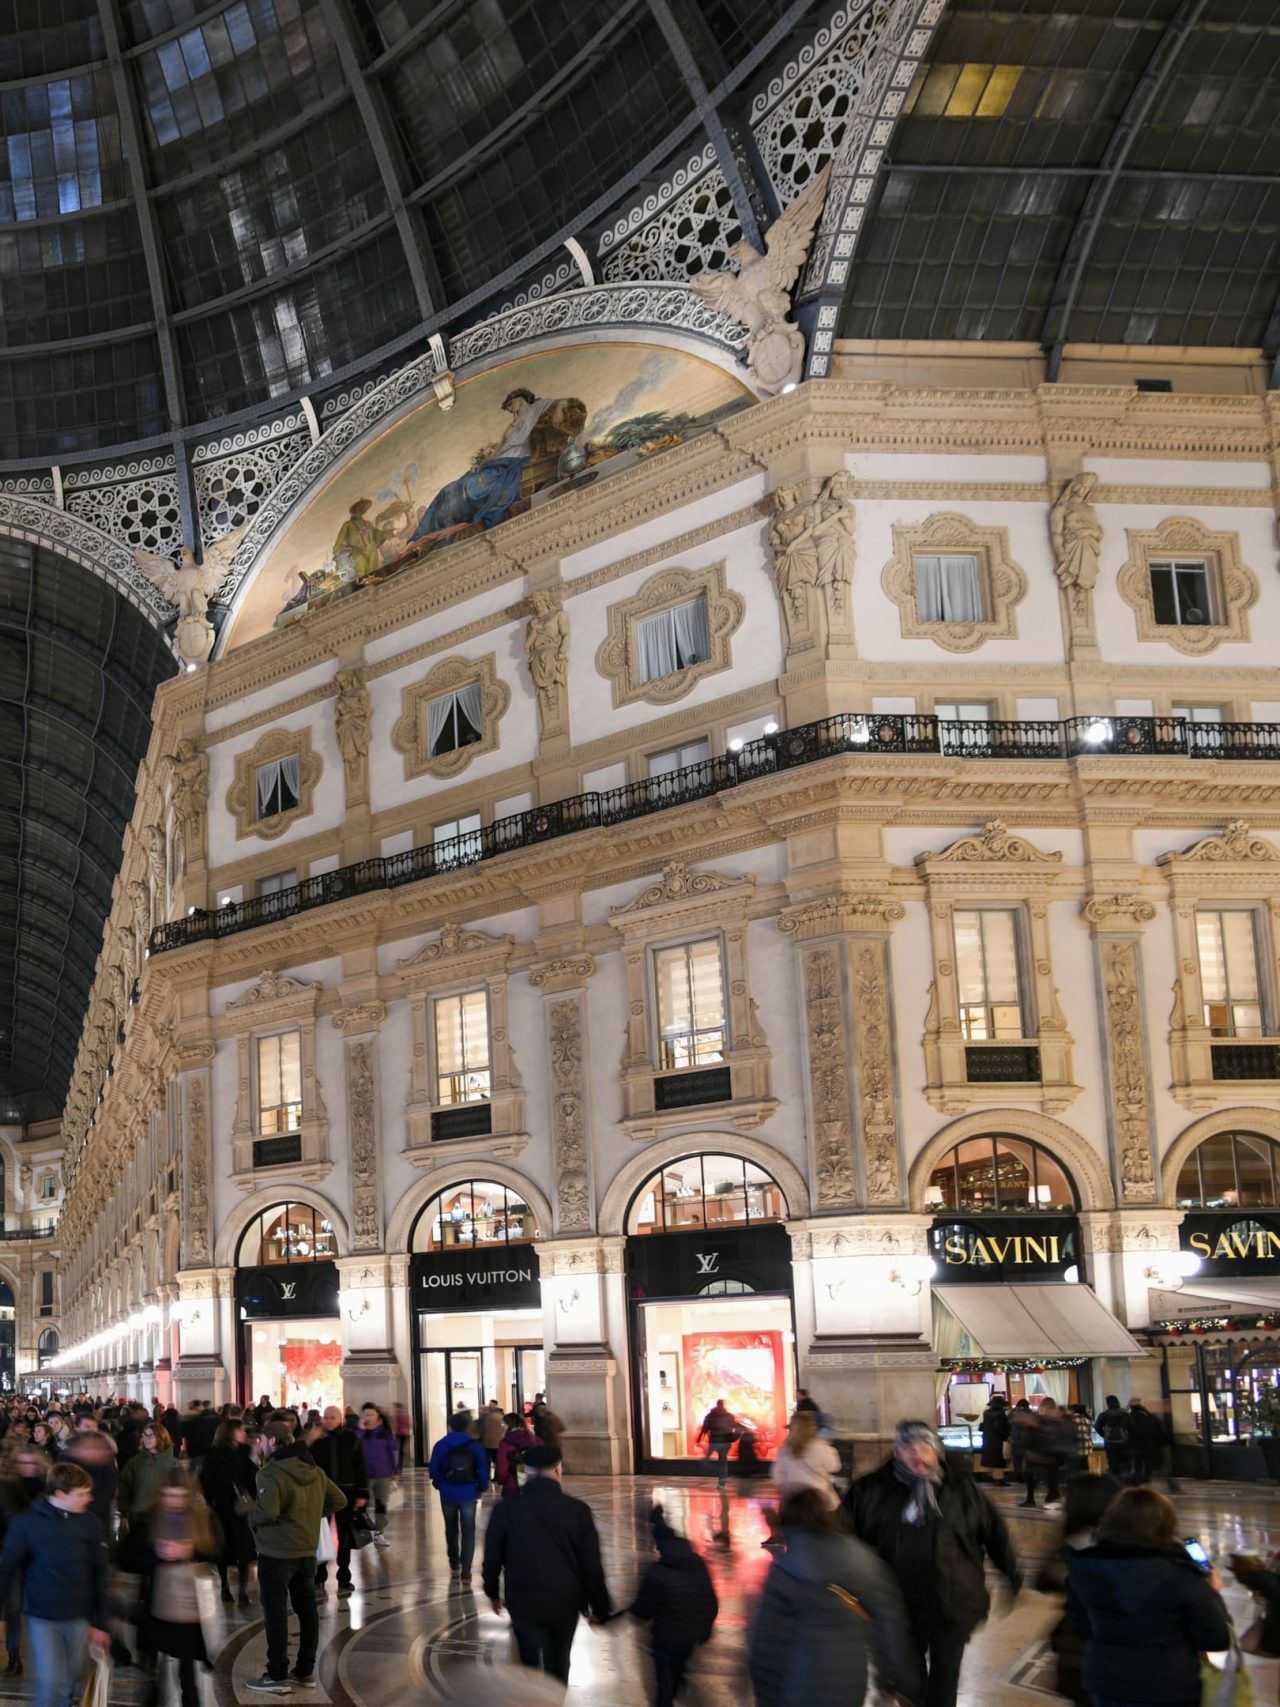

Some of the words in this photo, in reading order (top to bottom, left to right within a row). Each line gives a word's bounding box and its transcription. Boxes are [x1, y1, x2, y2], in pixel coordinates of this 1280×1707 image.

[944, 1235, 1060, 1265] SAVINI
[422, 1273, 463, 1288] LOUIS
[466, 1268, 532, 1286] VUITTON
